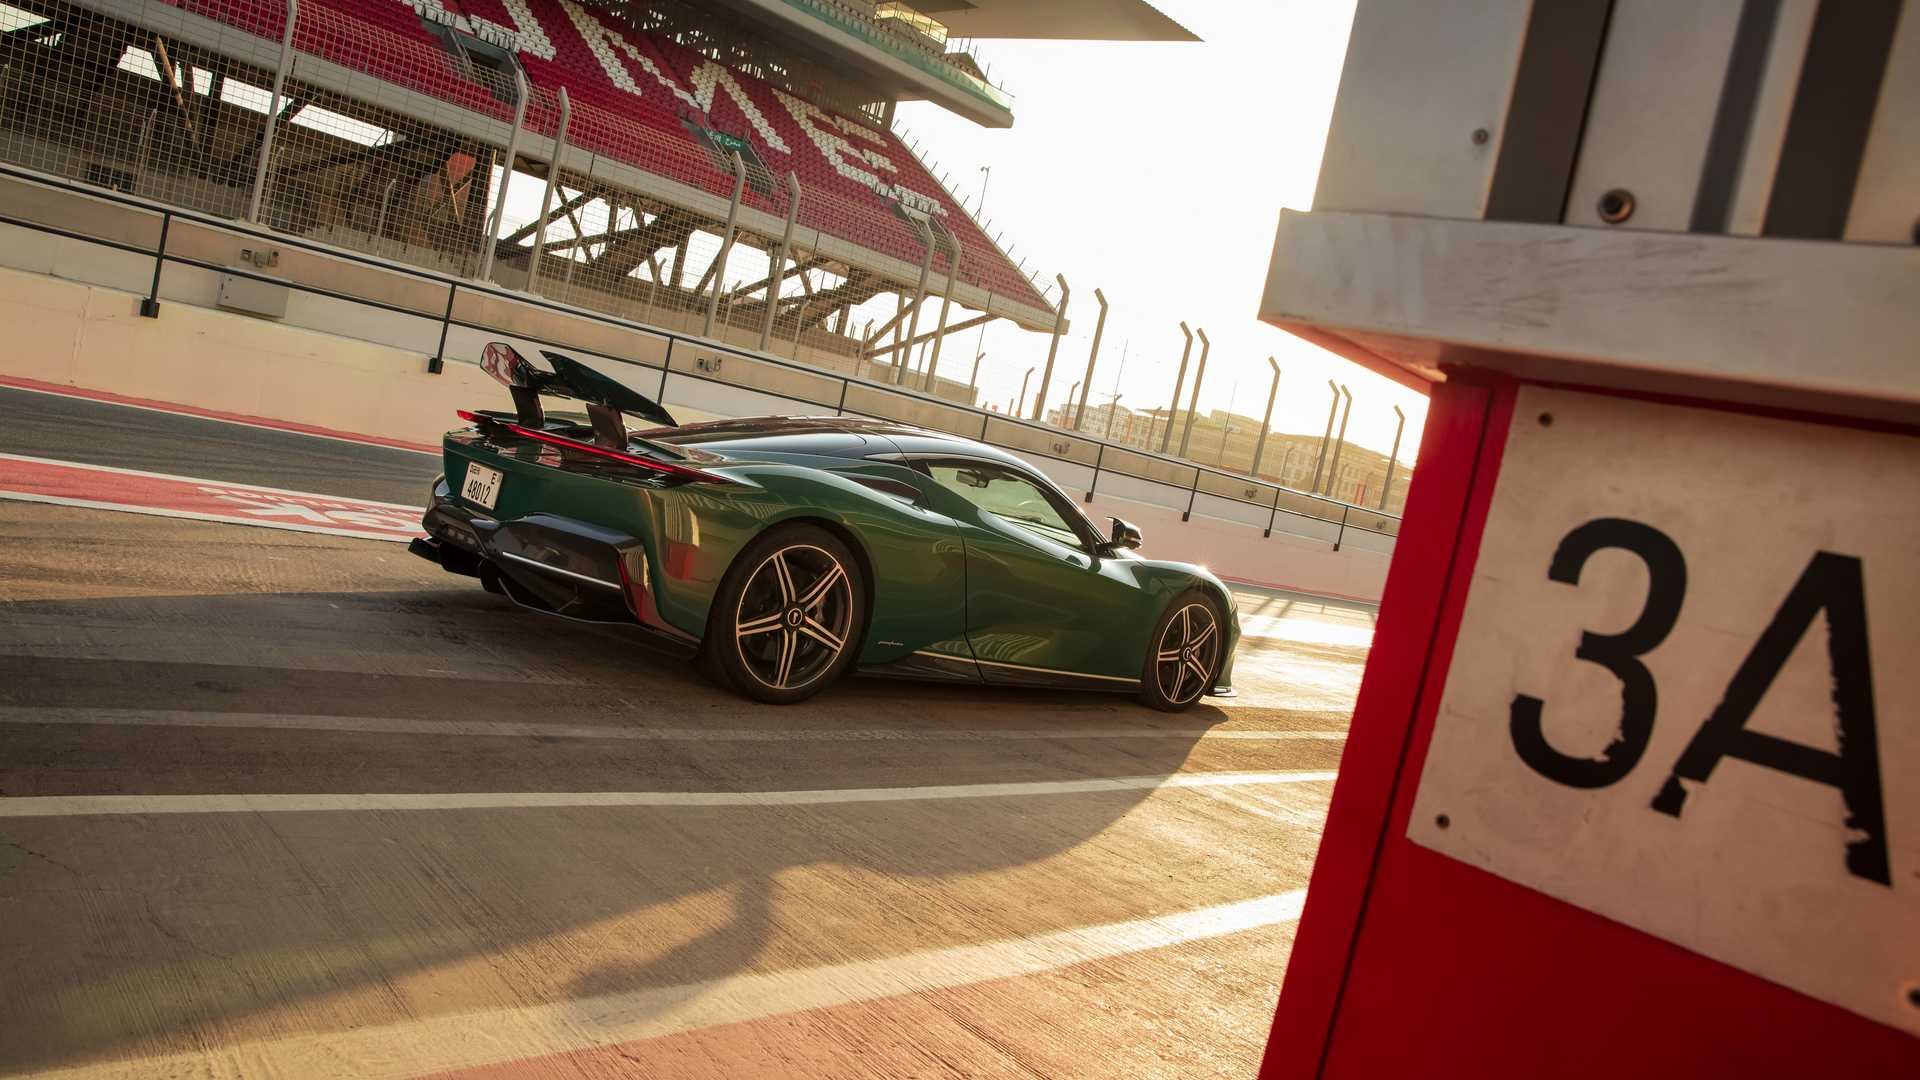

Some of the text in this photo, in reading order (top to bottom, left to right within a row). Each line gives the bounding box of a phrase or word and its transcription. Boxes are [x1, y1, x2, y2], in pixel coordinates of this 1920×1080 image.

[491, 472, 498, 485] E
[467, 479, 491, 505] 48012
[1509, 517, 1892, 888] 3A
